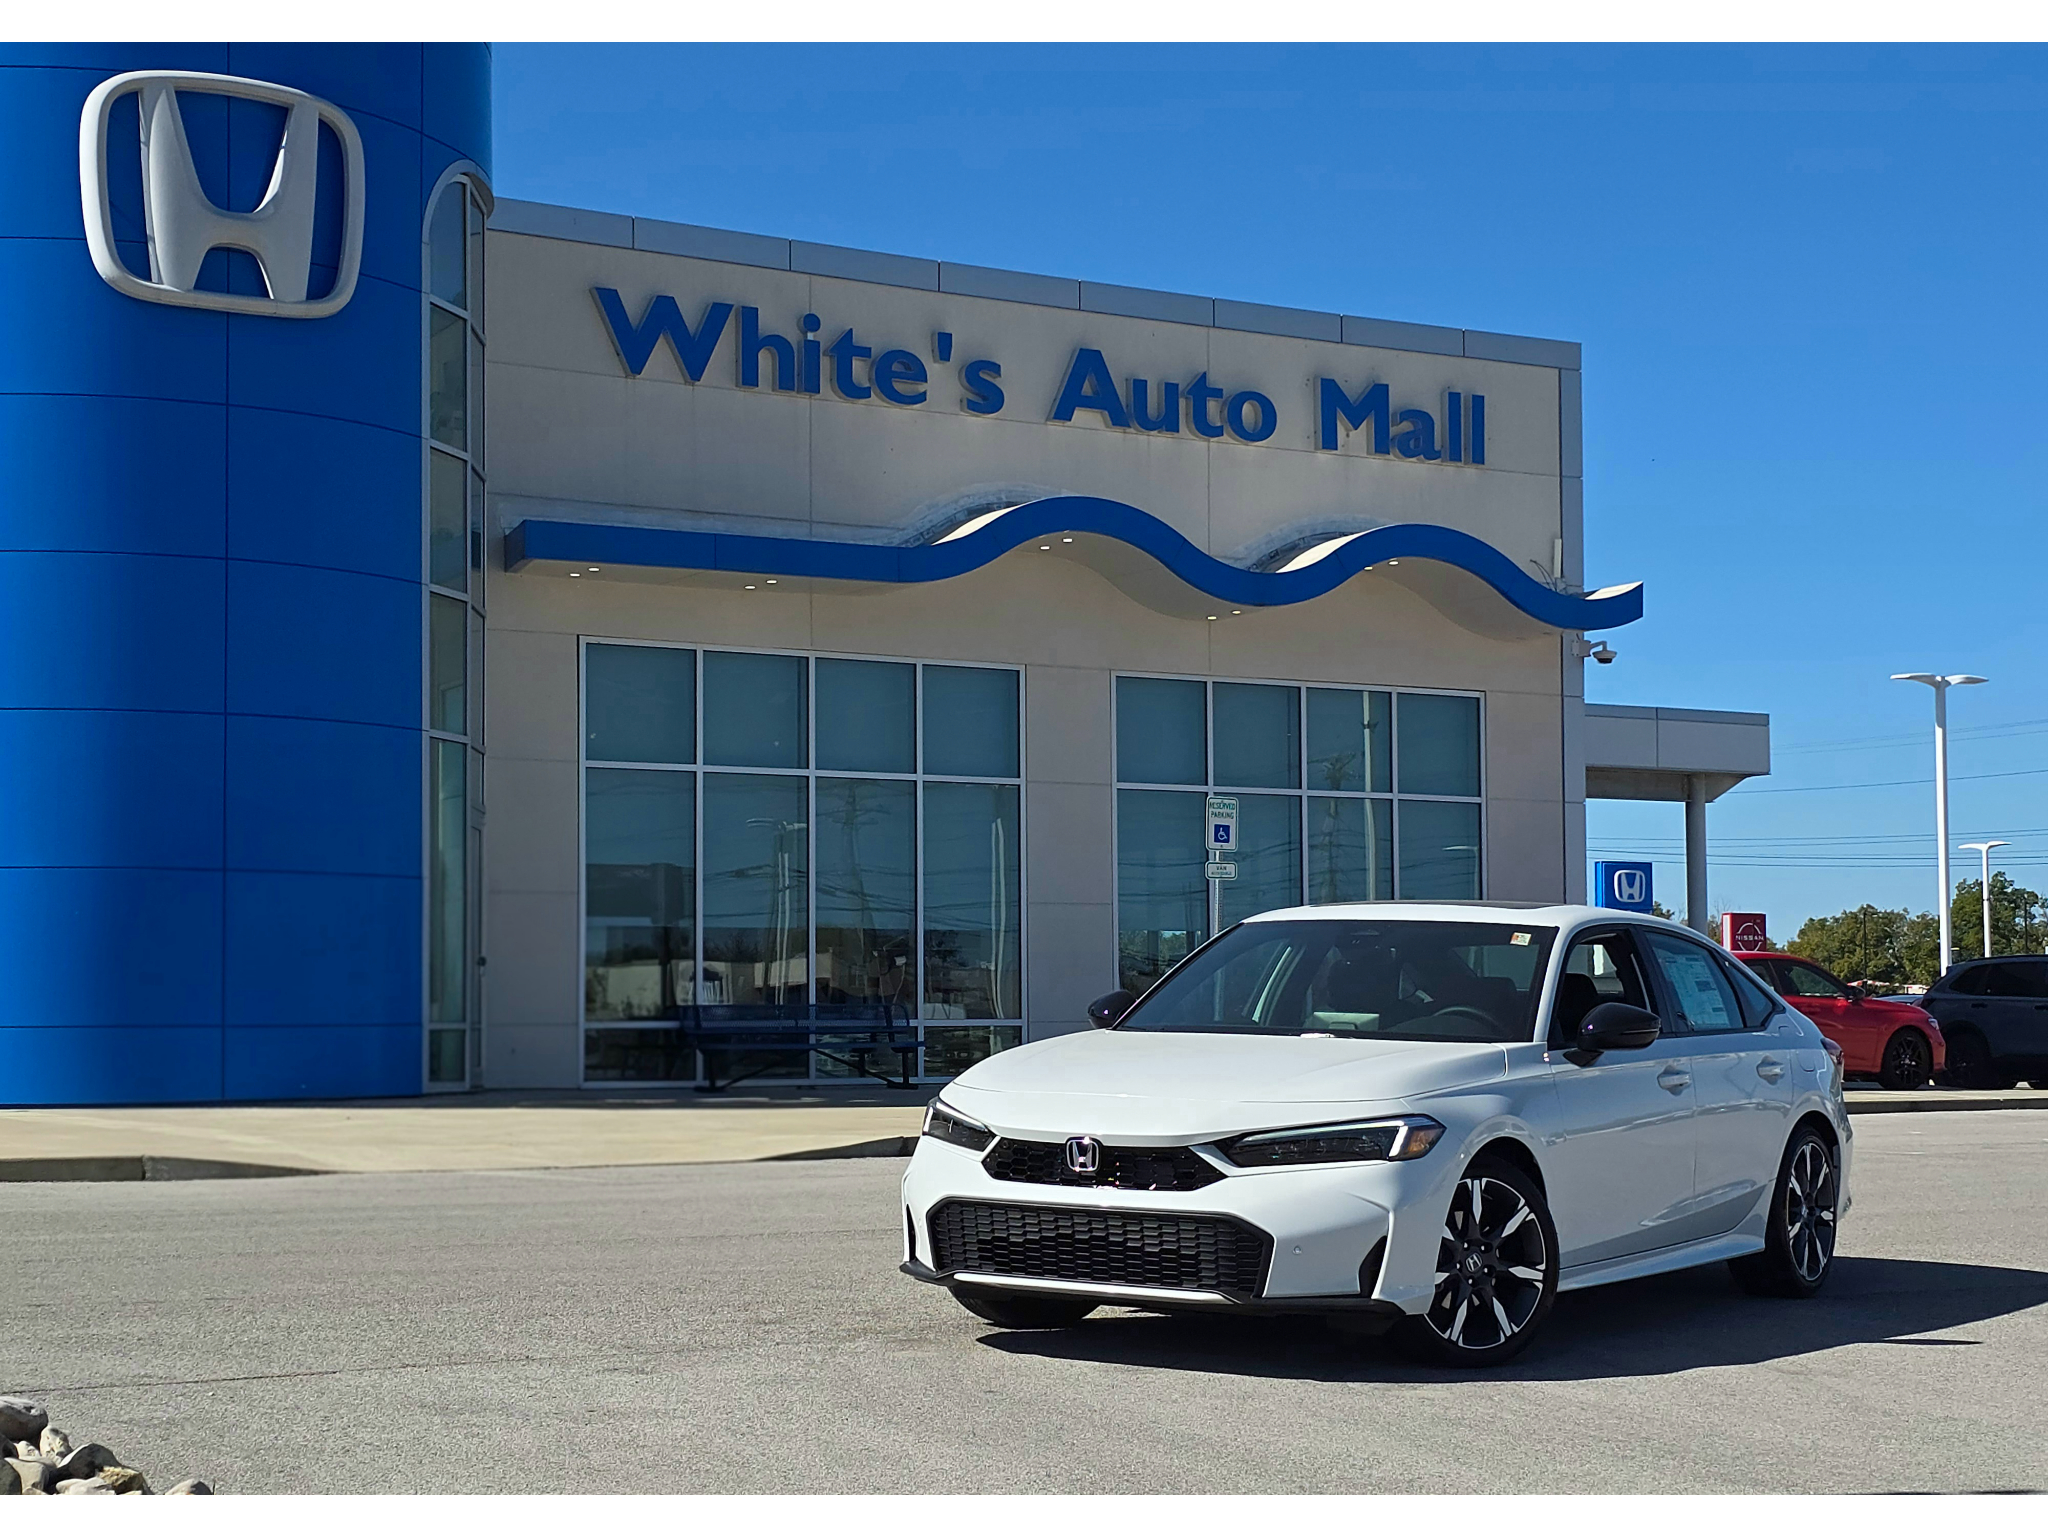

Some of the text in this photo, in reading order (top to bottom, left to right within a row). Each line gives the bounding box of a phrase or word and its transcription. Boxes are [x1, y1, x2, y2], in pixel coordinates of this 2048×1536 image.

[590, 286, 1485, 466] White's Auto Mall
[1209, 802, 1236, 811] RESERVED
[1210, 811, 1235, 820] PARKING
